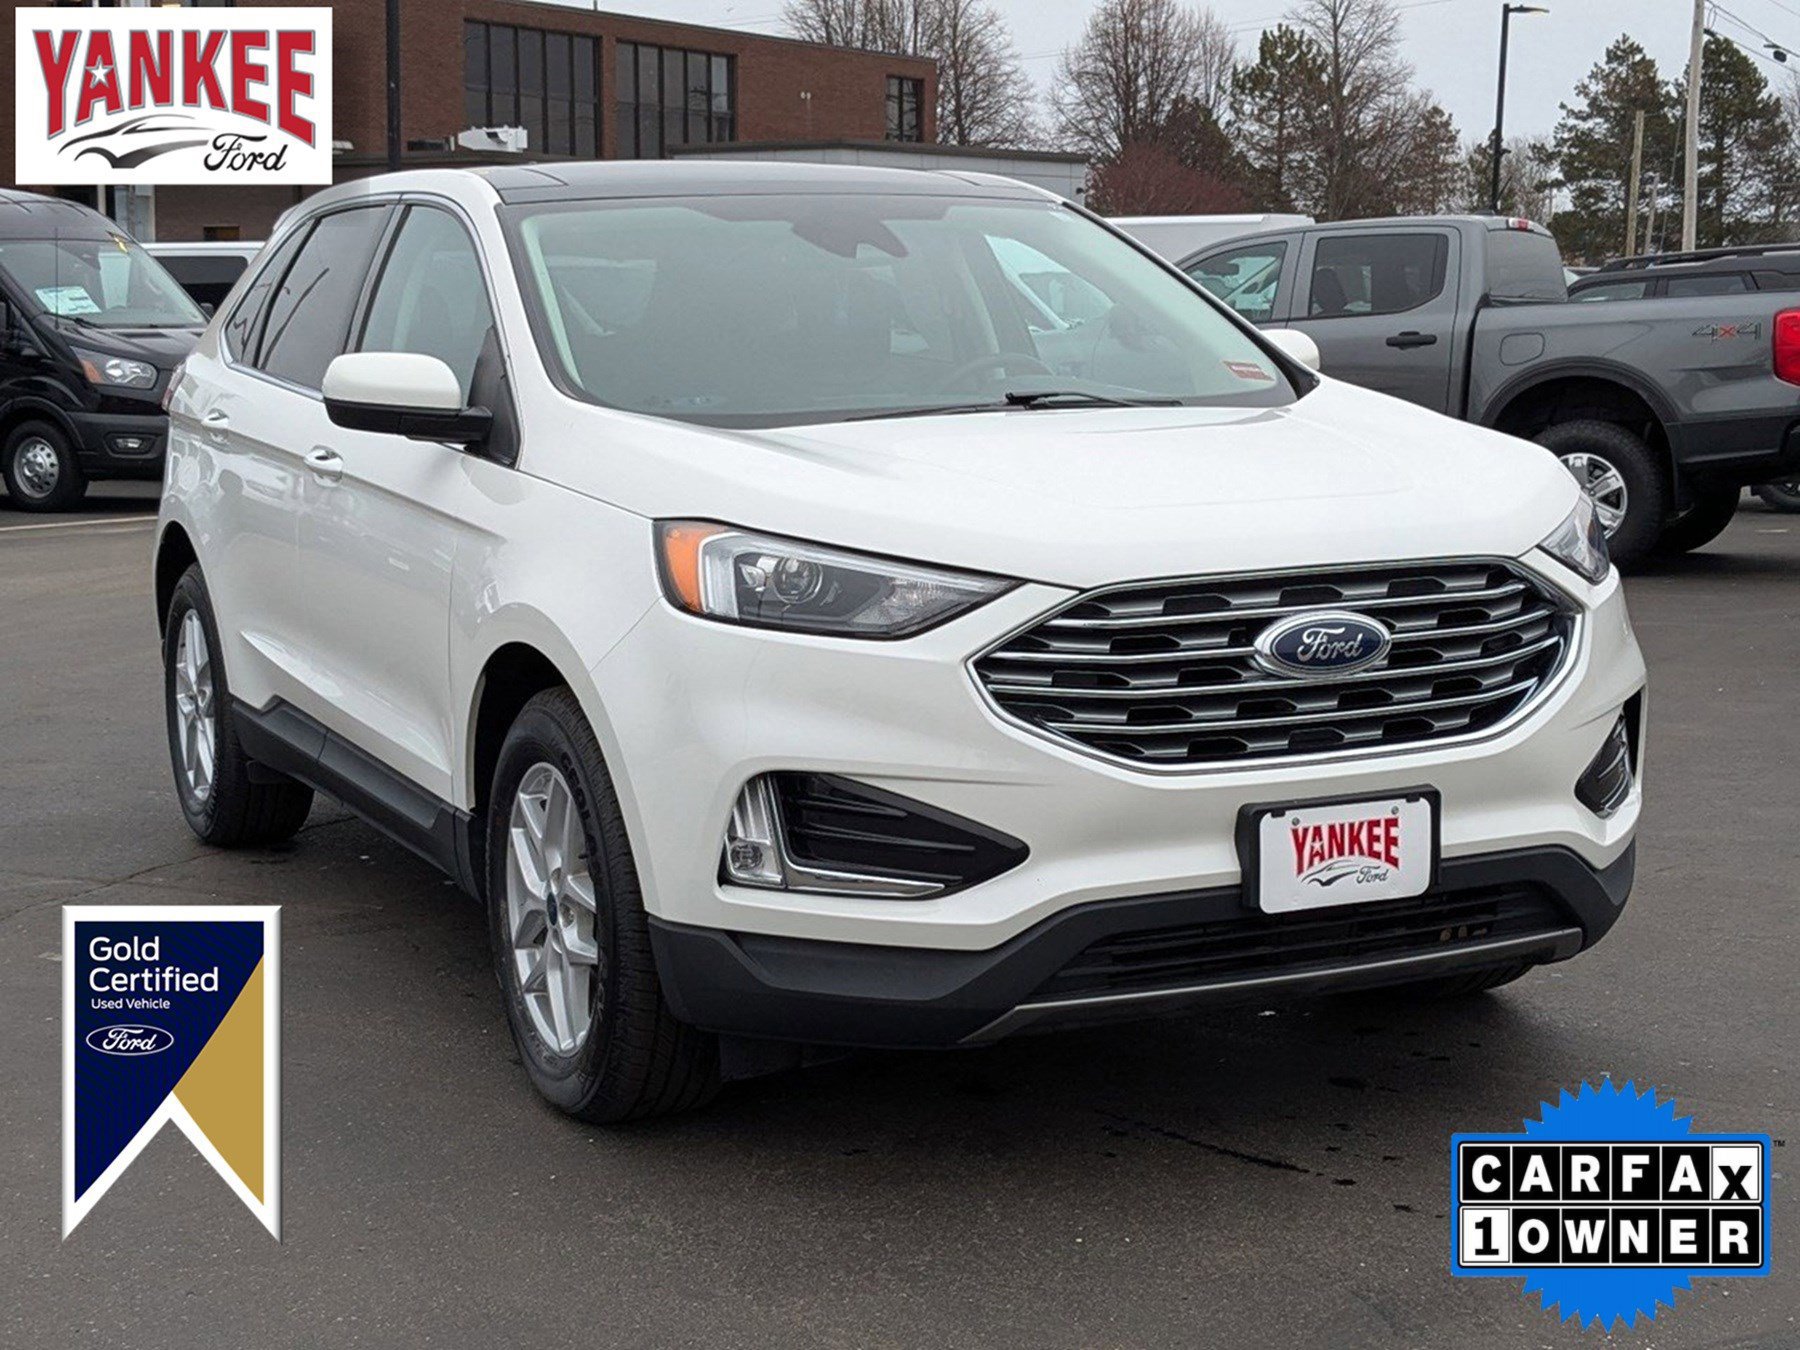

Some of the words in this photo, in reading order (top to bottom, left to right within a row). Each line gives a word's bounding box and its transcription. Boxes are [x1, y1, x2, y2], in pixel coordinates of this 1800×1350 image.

[1297, 627, 1363, 661] Ford
[1290, 817, 1399, 877] YANKEE
[1356, 866, 1389, 884] Ford
